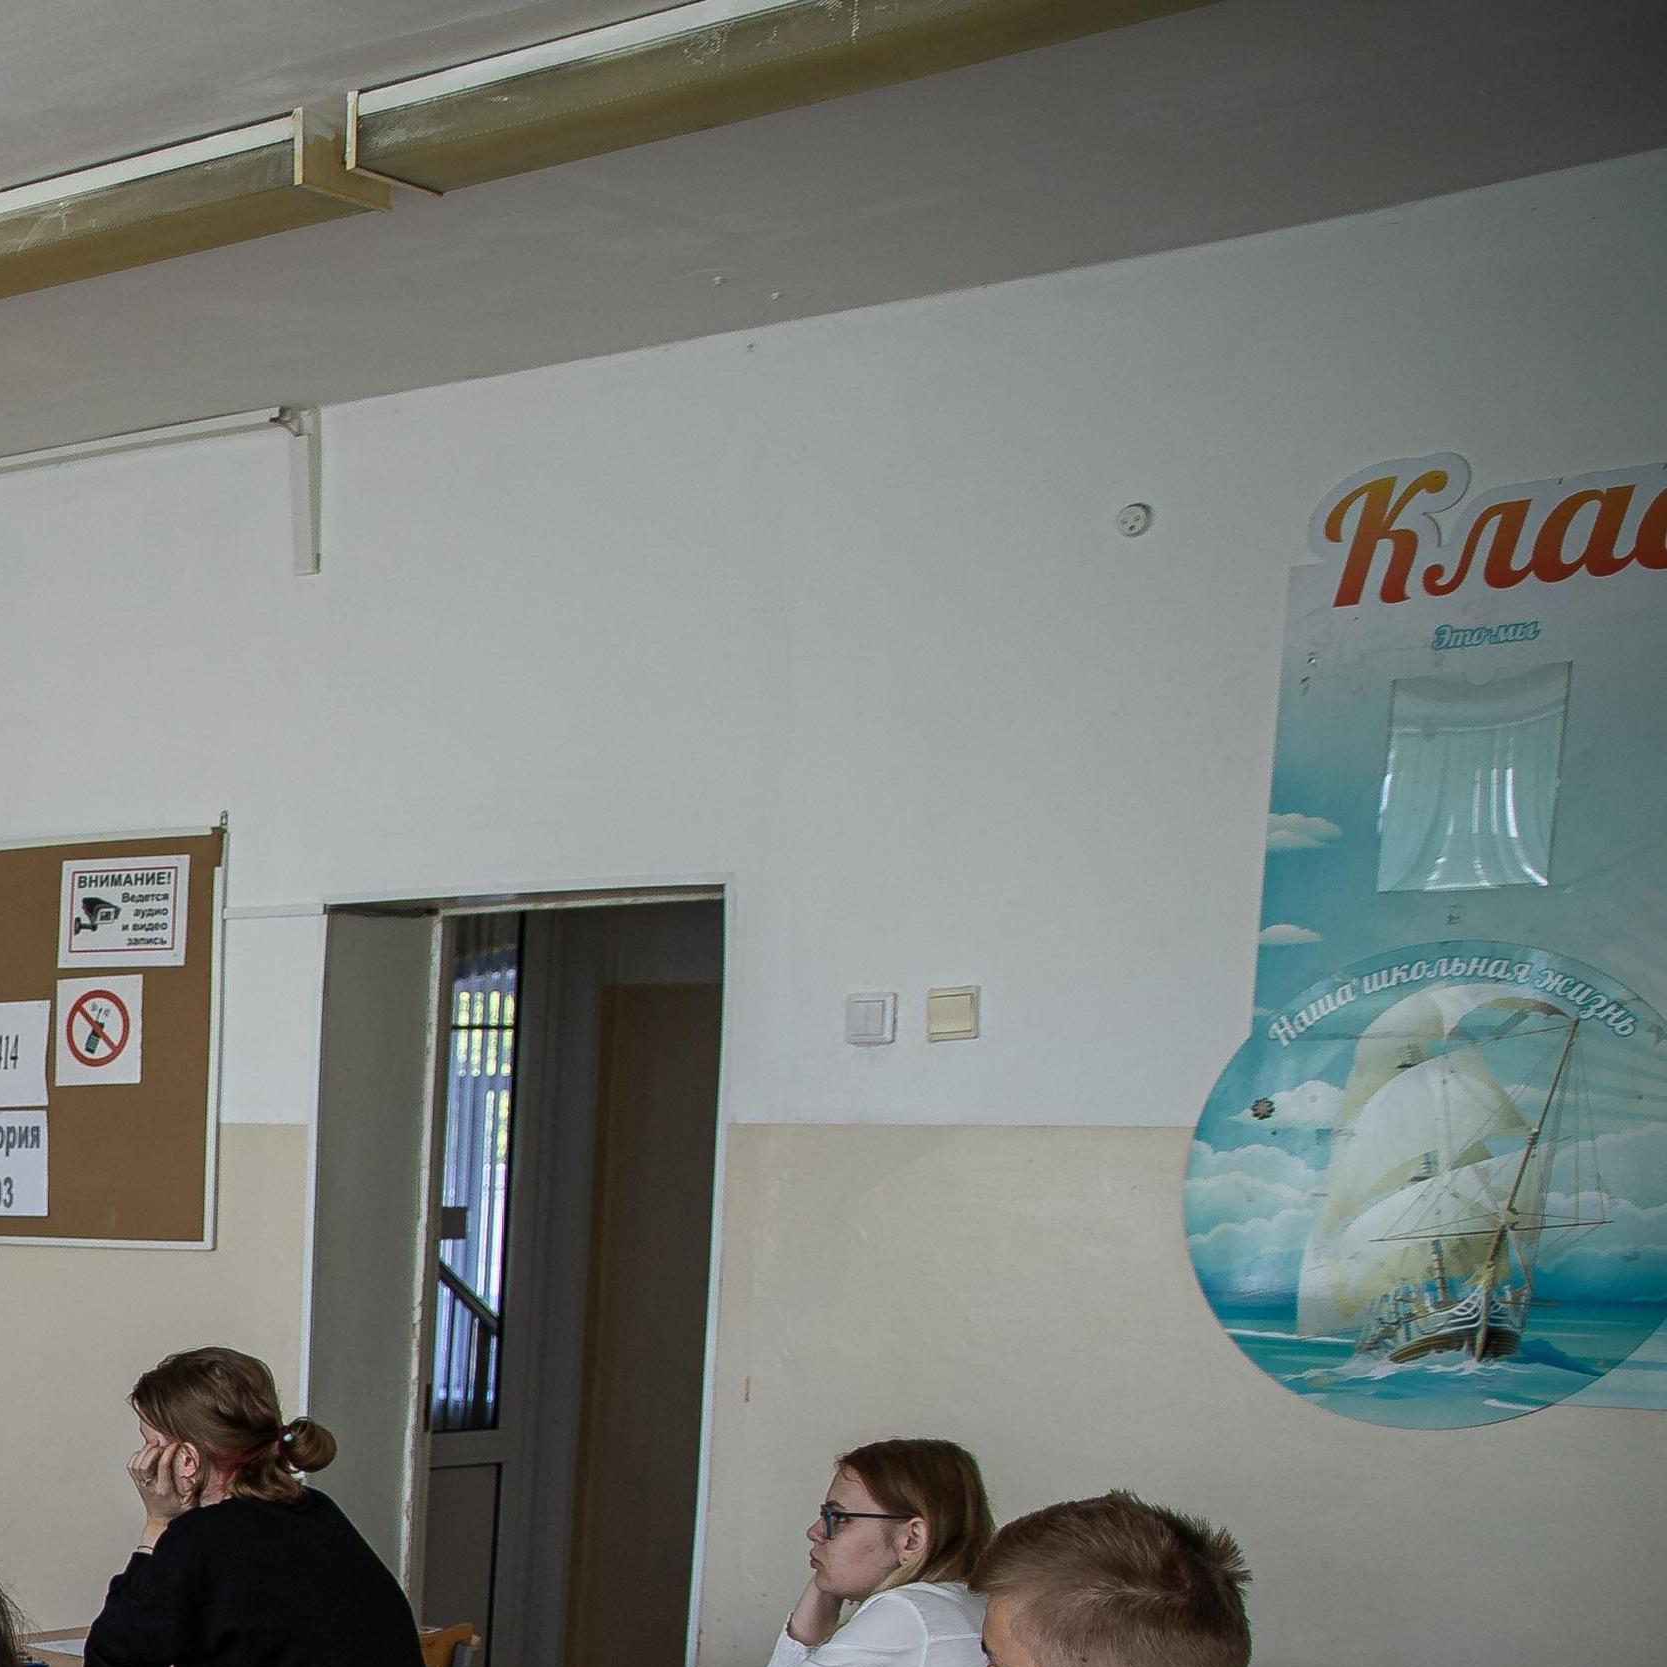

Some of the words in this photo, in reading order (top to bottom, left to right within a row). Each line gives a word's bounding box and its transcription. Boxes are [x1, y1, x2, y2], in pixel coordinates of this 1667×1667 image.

[1431, 623, 1488, 651] Это
[77, 872, 171, 889] ВНИМАНИЕ!
[121, 891, 169, 904] Ведется
[133, 907, 168, 920] аудио
[132, 921, 168, 932] видео
[126, 936, 167, 947] запись
[1267, 980, 1357, 1047] Наша
[1363, 955, 1532, 996] школьная
[1534, 966, 1638, 1039] жизнь
